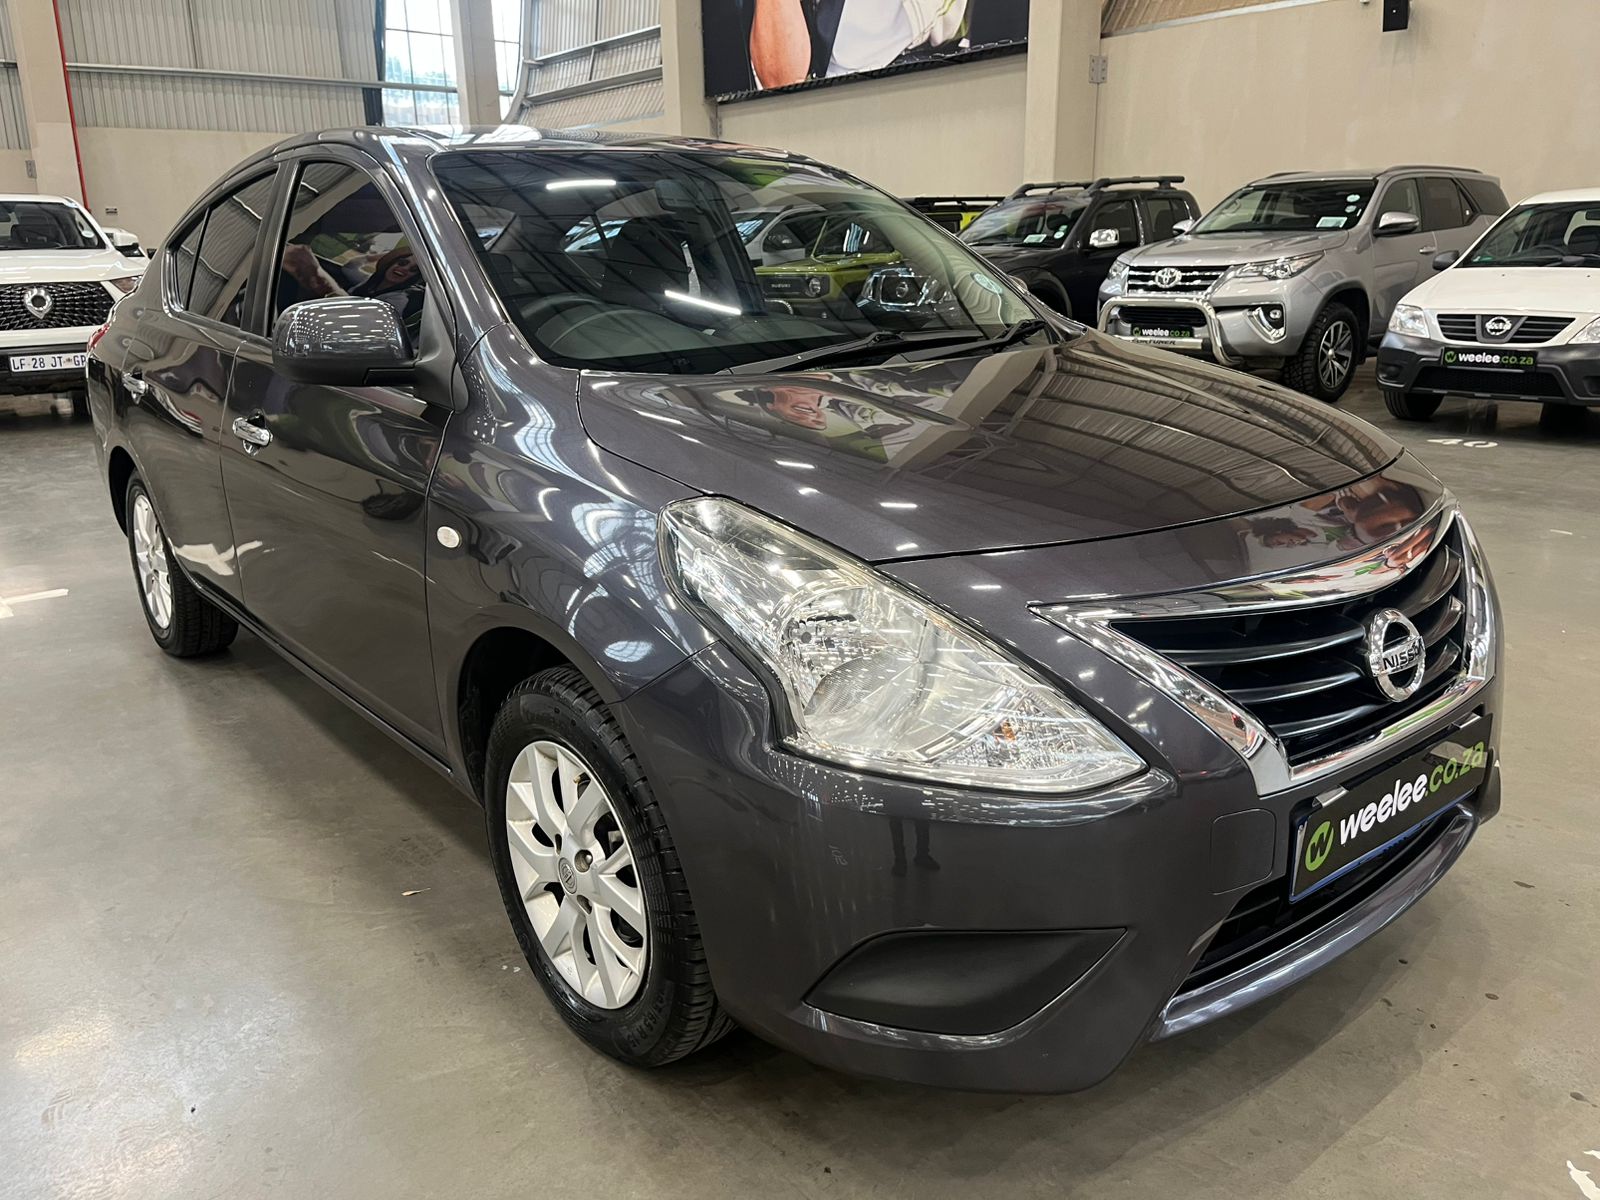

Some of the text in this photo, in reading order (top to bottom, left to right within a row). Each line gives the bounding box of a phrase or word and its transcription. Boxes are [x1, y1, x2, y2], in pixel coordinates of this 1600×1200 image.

[12, 354, 86, 371] LF 28 JT GP
[1458, 351, 1534, 365] weelee.co.za
[1339, 741, 1485, 845] weelee.co.za
